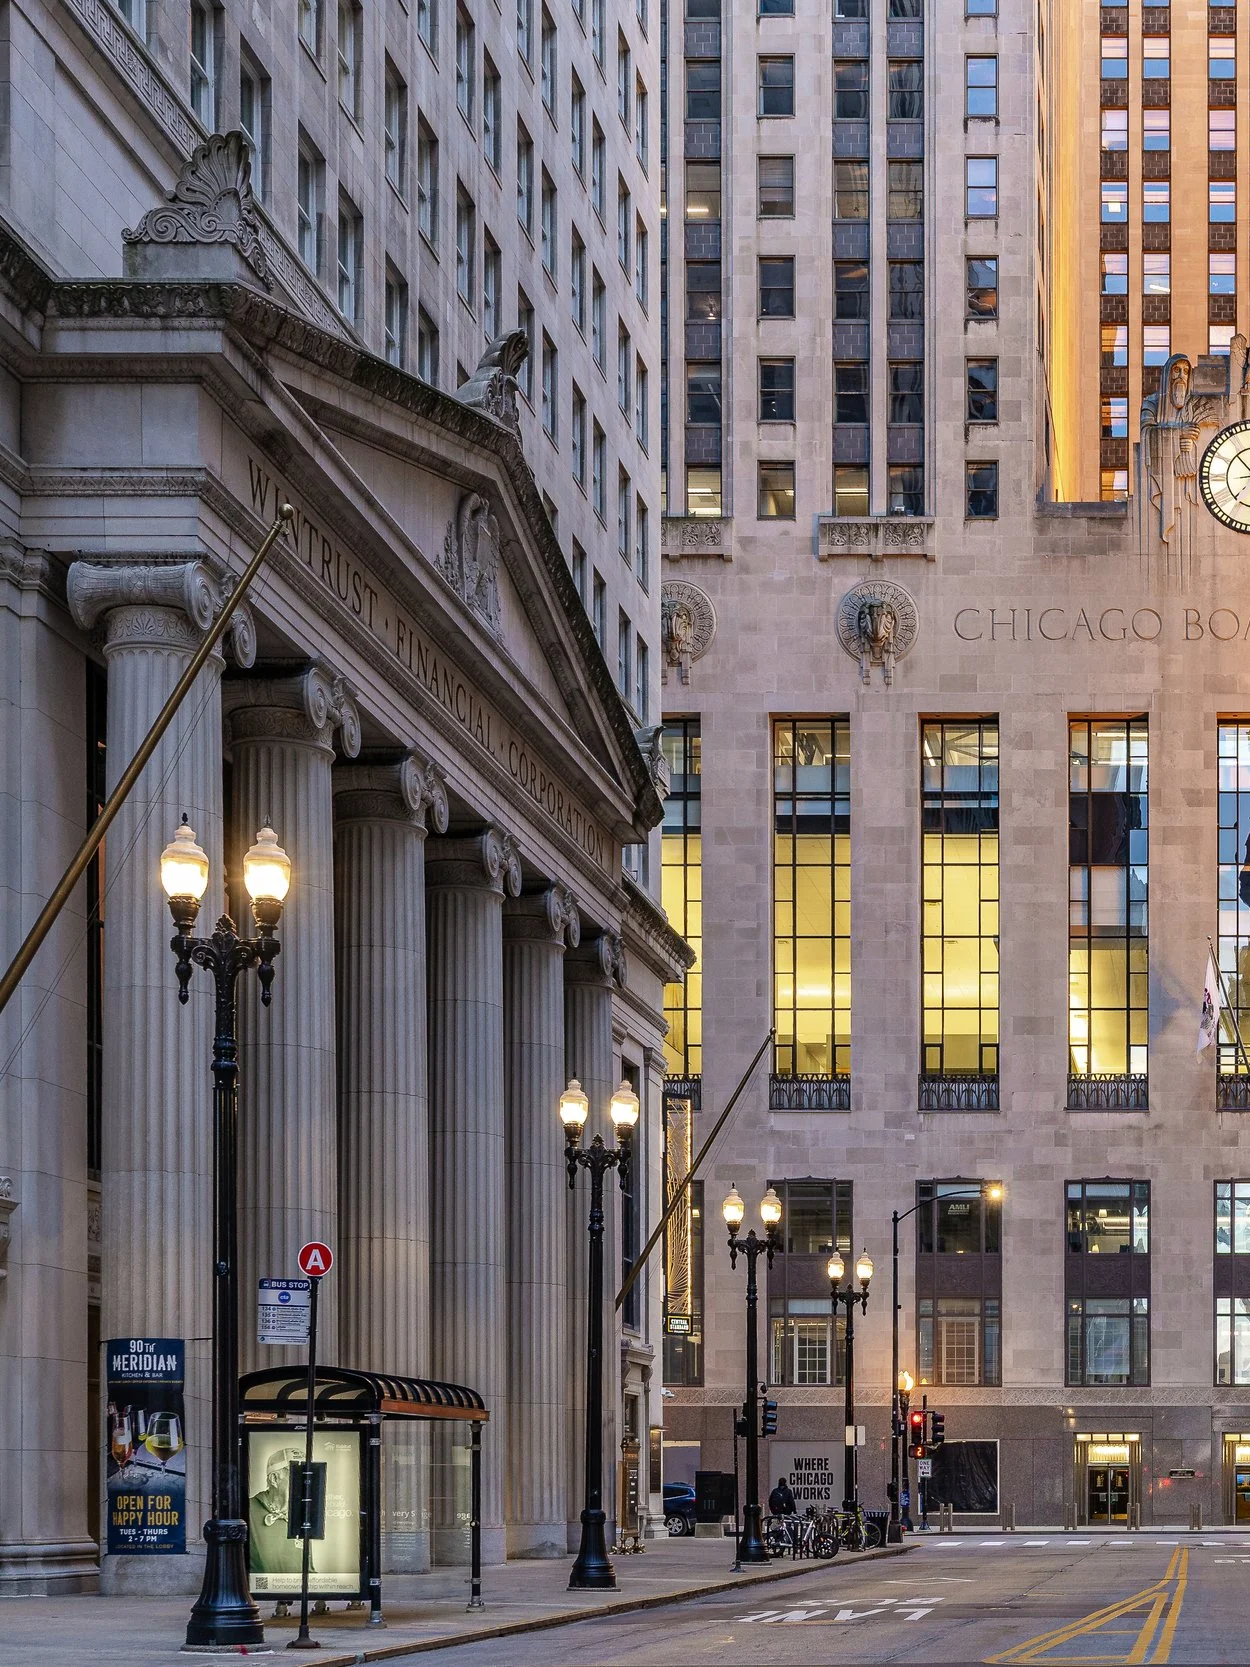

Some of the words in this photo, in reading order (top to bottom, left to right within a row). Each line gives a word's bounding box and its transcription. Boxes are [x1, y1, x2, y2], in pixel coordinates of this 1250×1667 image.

[953, 607, 1163, 642] CHICAGO
[248, 455, 378, 631] WINTRUST
[395, 616, 496, 756] FINANCIAL
[508, 741, 604, 864] CORPORATION
[306, 1249, 325, 1270] A
[288, 1281, 309, 1289] STOP
[112, 1354, 178, 1371] MERIDIAN
[794, 1457, 829, 1471] WHERE
[790, 1472, 834, 1486] CHICAGO
[793, 1487, 830, 1500] WORKS
[117, 1495, 144, 1510] OPEN
[147, 1495, 171, 1510] FOR
[112, 1511, 143, 1526] HAPPY
[147, 1511, 179, 1526] HOUR
